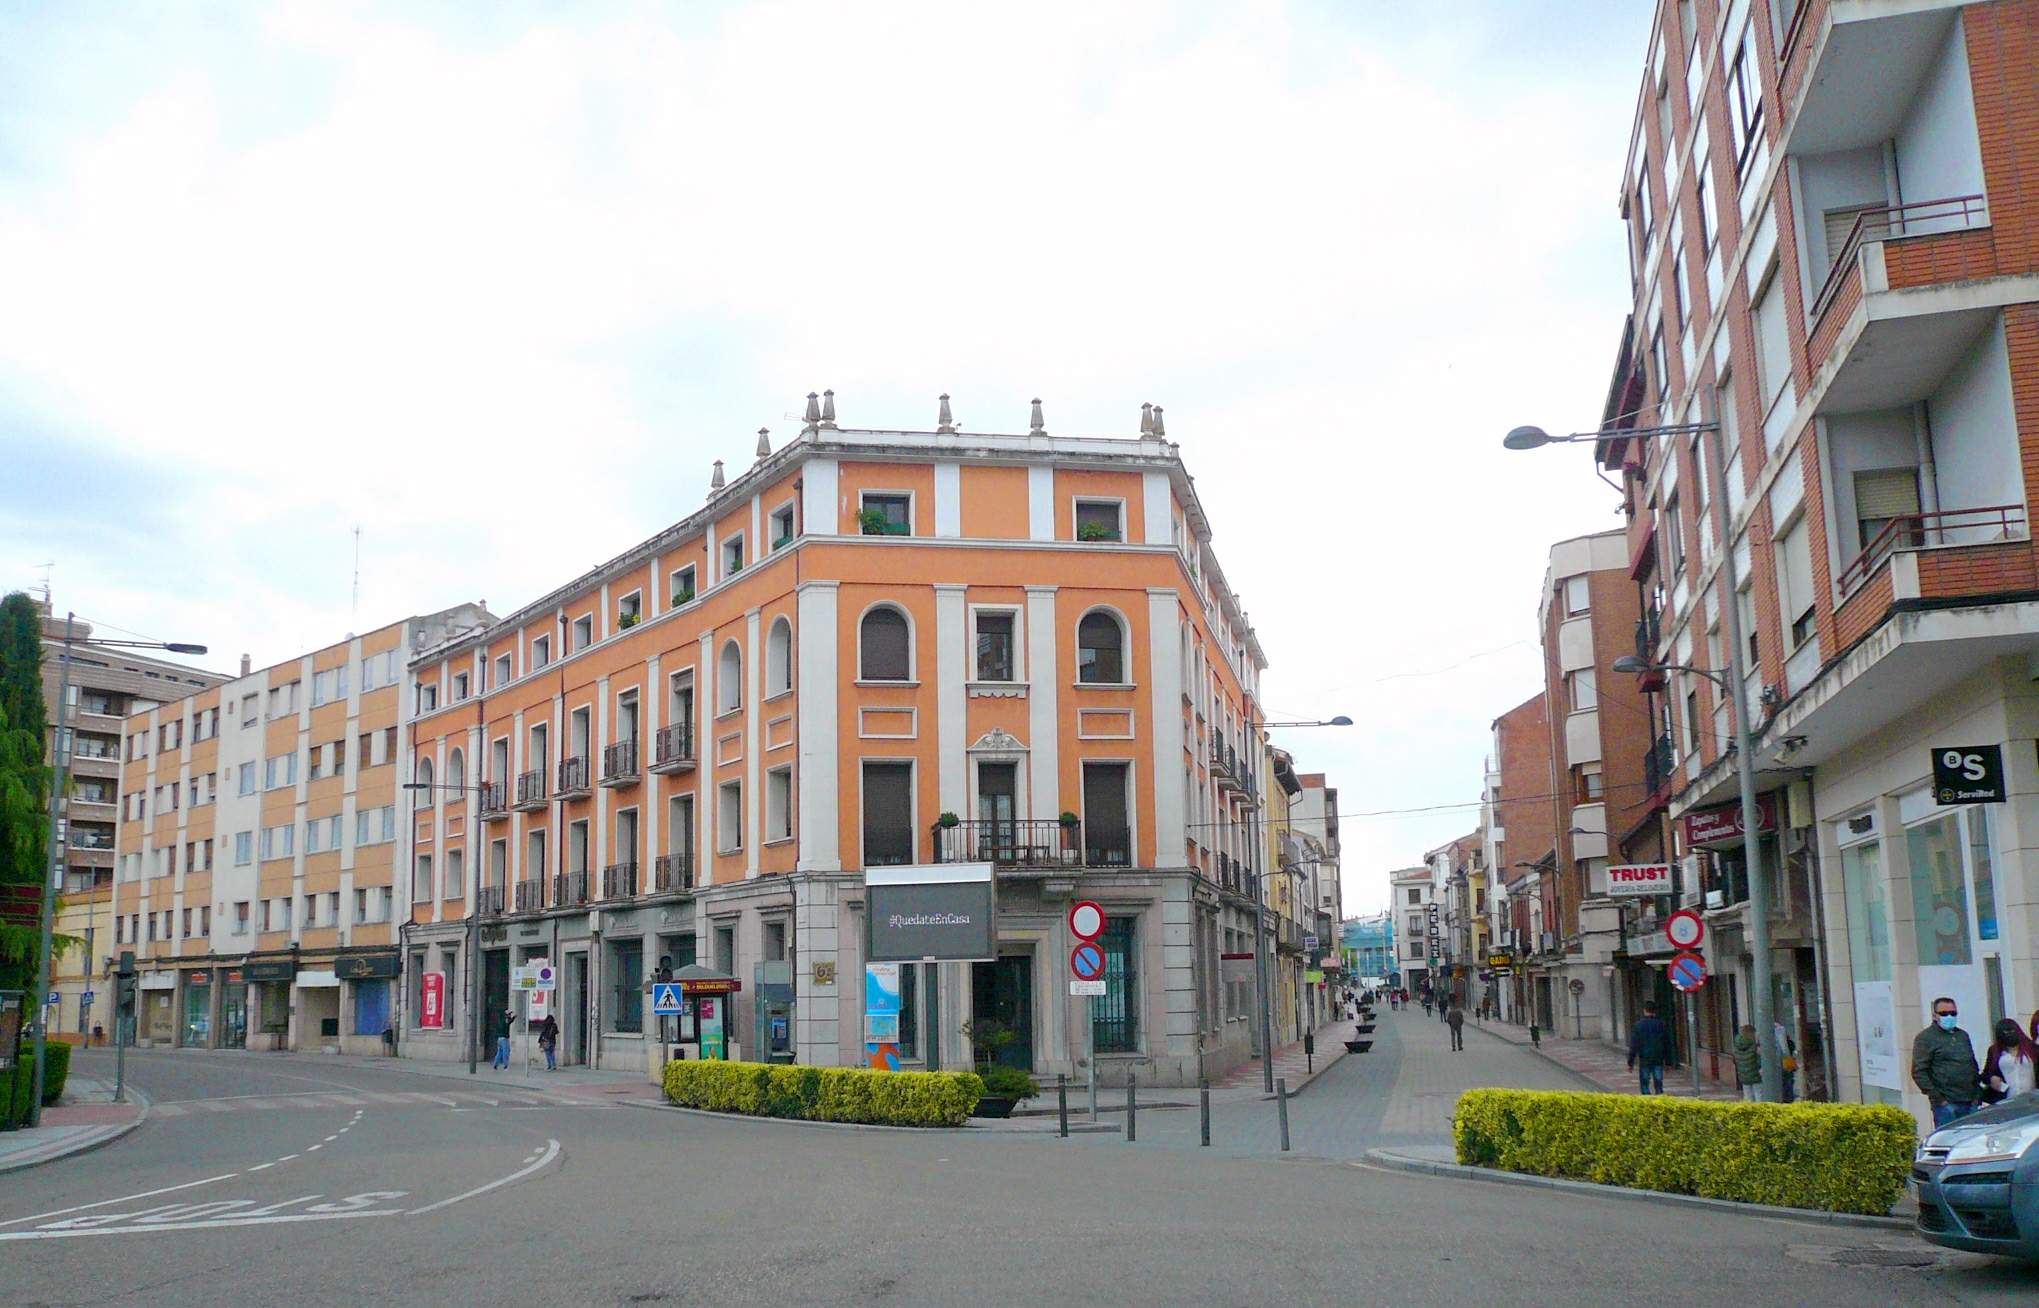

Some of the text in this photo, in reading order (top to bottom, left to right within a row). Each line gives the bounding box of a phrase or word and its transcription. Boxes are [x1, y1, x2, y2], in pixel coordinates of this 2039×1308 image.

[1957, 789, 1995, 799] ServiRed
[1609, 866, 1668, 881] TRUST
[889, 913, 970, 928] #QuedateEnCasa
